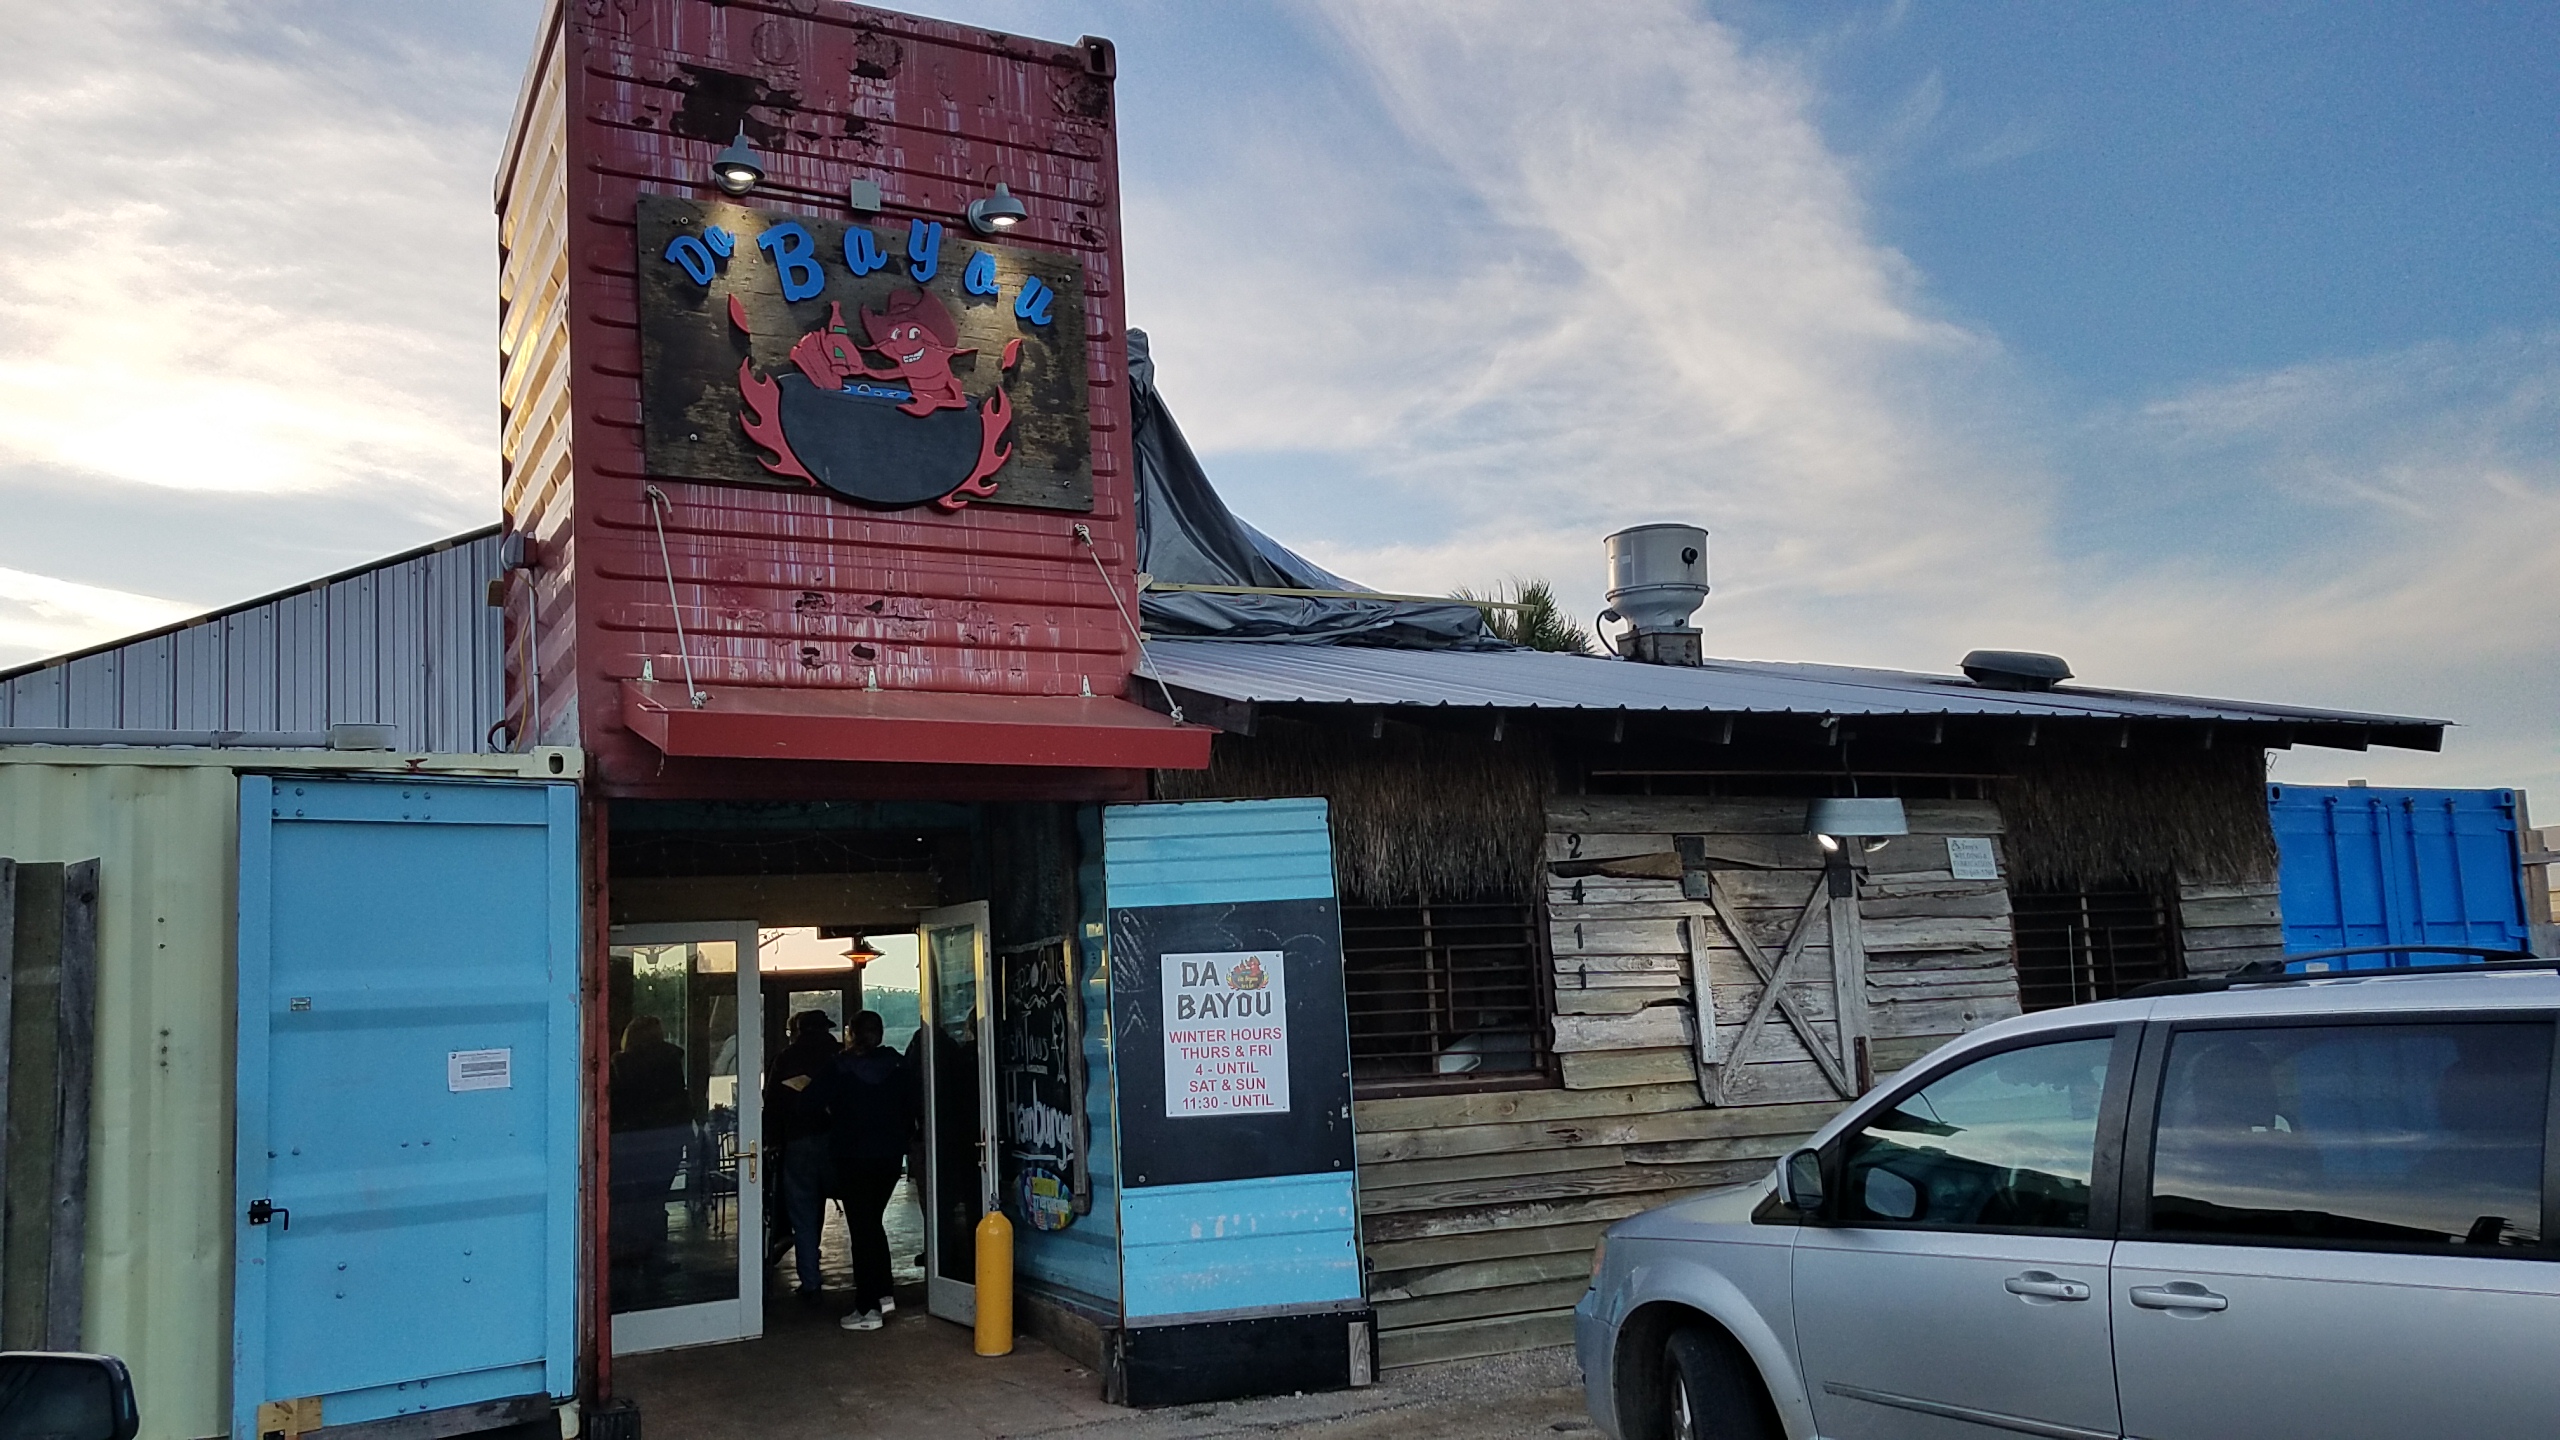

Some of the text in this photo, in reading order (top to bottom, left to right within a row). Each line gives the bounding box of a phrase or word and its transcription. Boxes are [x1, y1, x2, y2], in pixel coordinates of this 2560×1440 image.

[664, 225, 736, 286] Da
[1181, 960, 1220, 988] DA
[1177, 991, 1272, 1021] BAYOU
[1169, 1027, 1283, 1044] WINTER HOURS
[1180, 1044, 1272, 1060] THURS & FRI
[1195, 1063, 1203, 1076] 4
[1216, 1061, 1259, 1075] UNTIL
[1189, 1077, 1266, 1093] SAT & SUN
[1182, 1096, 1219, 1110] 11:30
[1231, 1093, 1275, 1108] UNTIL
[1005, 1069, 1074, 1172] Hamburge
